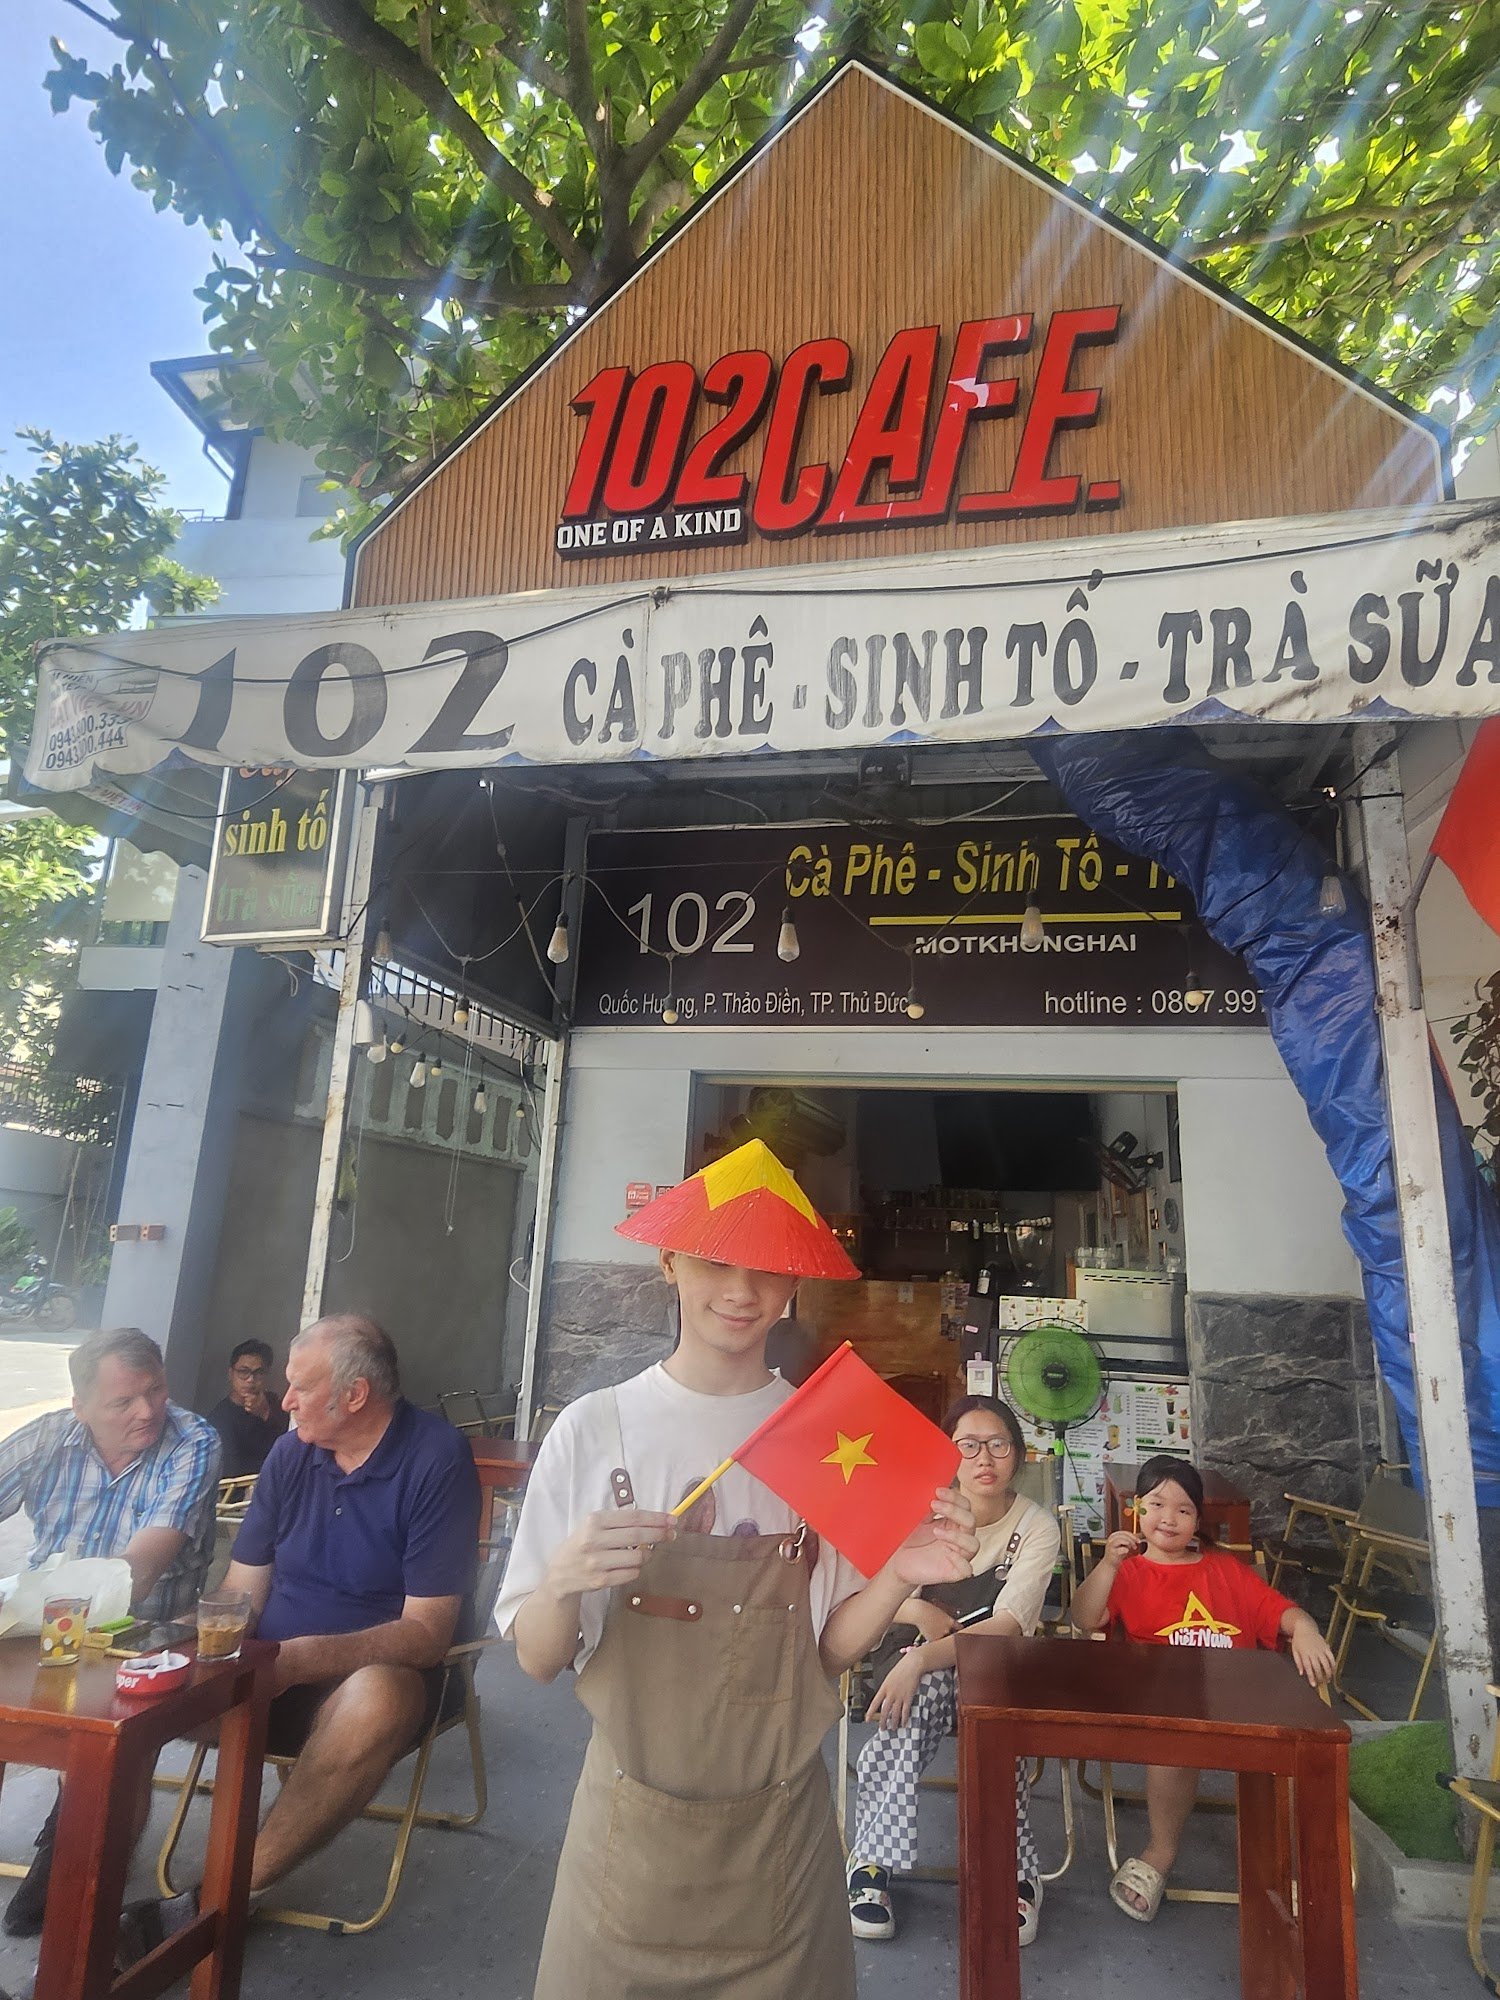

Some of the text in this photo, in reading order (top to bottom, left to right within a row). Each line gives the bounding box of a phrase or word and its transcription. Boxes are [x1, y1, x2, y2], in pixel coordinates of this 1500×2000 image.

[557, 508, 741, 549] ONE OF A KIND
[160, 630, 516, 757] 102
[563, 628, 639, 746] CÀ
[658, 614, 774, 740] PHÊ
[825, 626, 988, 730] SINH
[1005, 569, 1103, 706] TỐ
[1158, 570, 1320, 704] TRÀ
[1347, 558, 1500, 687] SỮA
[223, 789, 329, 856] sinh tố
[785, 844, 833, 898] Cà
[844, 842, 917, 896] Phê
[953, 840, 1040, 895] Sinh
[627, 891, 756, 954] 102
[599, 989, 639, 1015] Quốc
[704, 992, 717, 1013] P.
[723, 990, 761, 1014] Thảo
[765, 987, 805, 1016] Điền,
[810, 992, 835, 1014] TP.
[840, 990, 870, 1014] Thủ
[874, 991, 908, 1014] Đức
[1045, 990, 1128, 1014] hotline
